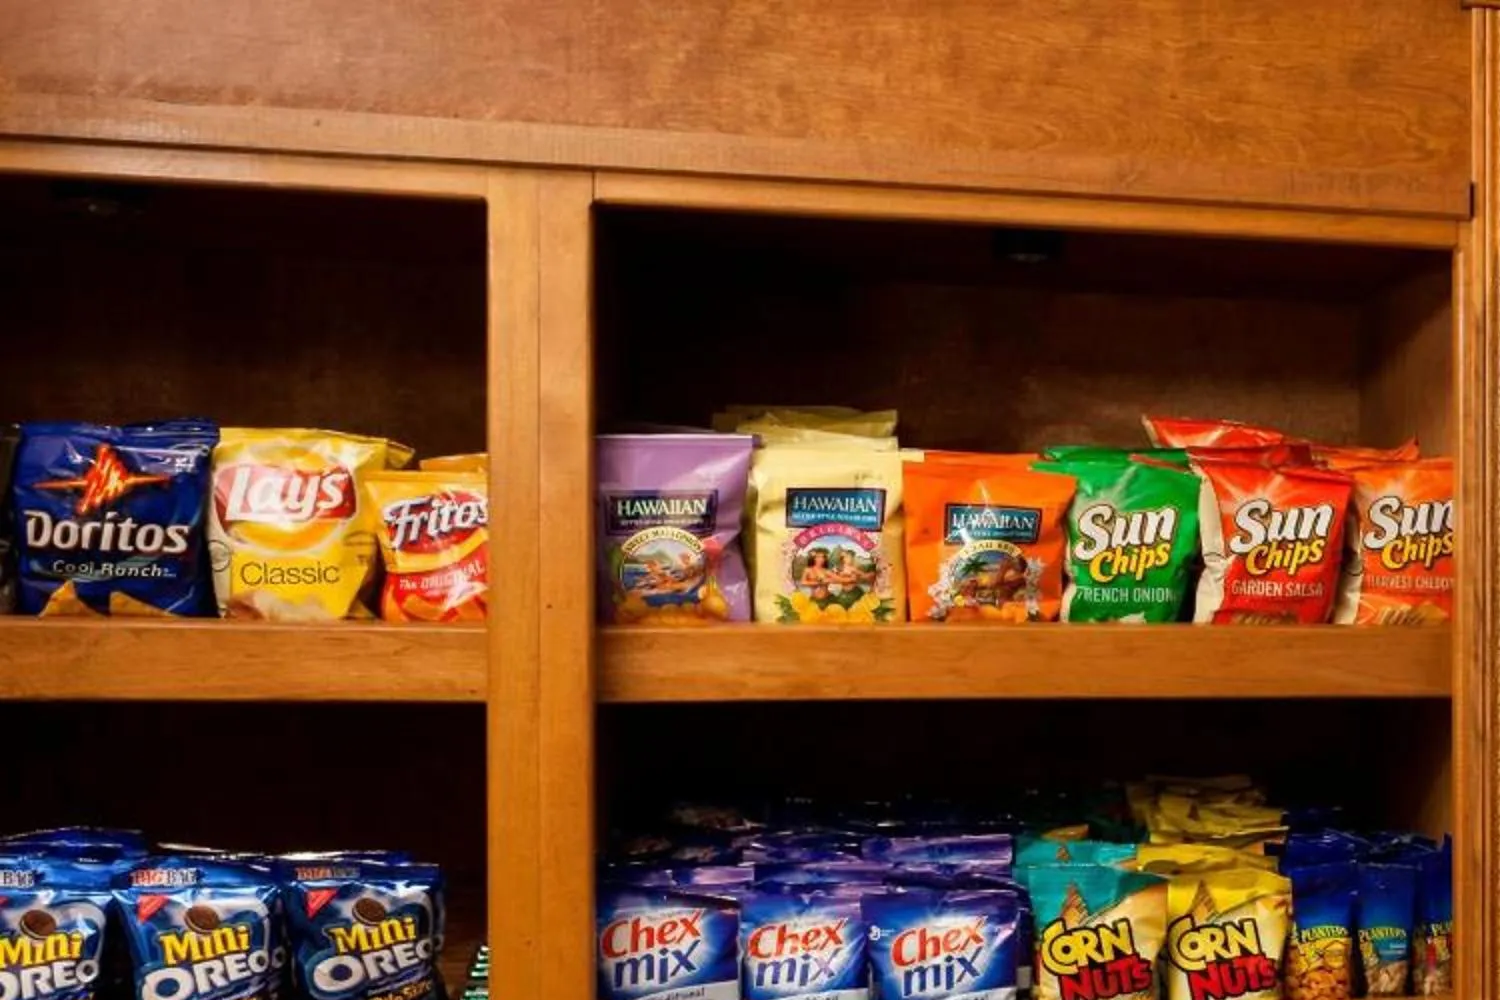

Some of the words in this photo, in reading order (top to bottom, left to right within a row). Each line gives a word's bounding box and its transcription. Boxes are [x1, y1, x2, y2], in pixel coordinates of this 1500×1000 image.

[618, 499, 707, 517] HAWAIIAN
[794, 496, 876, 512] HAWAIIAN
[953, 511, 1035, 529] HAWAIIAN
[1364, 496, 1453, 550] Sun
[23, 510, 190, 554] Doritos
[1074, 503, 1178, 560] Sun
[1230, 498, 1334, 554] Sun
[52, 559, 94, 575] Cool
[100, 562, 163, 577] Ranch
[1090, 542, 1172, 583] Chips
[1246, 540, 1326, 577] Chips
[1382, 536, 1454, 571] Chips
[240, 562, 341, 587] Classic
[1076, 586, 1129, 602] FRENCH
[1231, 581, 1282, 597] GARDEN
[1286, 582, 1324, 597] SALSA
[0, 931, 83, 967] Mini
[160, 926, 250, 966] Mini
[329, 917, 417, 954] Mini
[601, 909, 701, 958] Chex
[747, 917, 845, 958] Chex
[891, 917, 984, 967] Chex
[1041, 918, 1135, 975] CORN
[1167, 914, 1262, 972] CORN
[313, 938, 433, 992] OREO
[614, 940, 700, 988] mix
[756, 947, 841, 988] mix
[903, 946, 984, 997] mix
